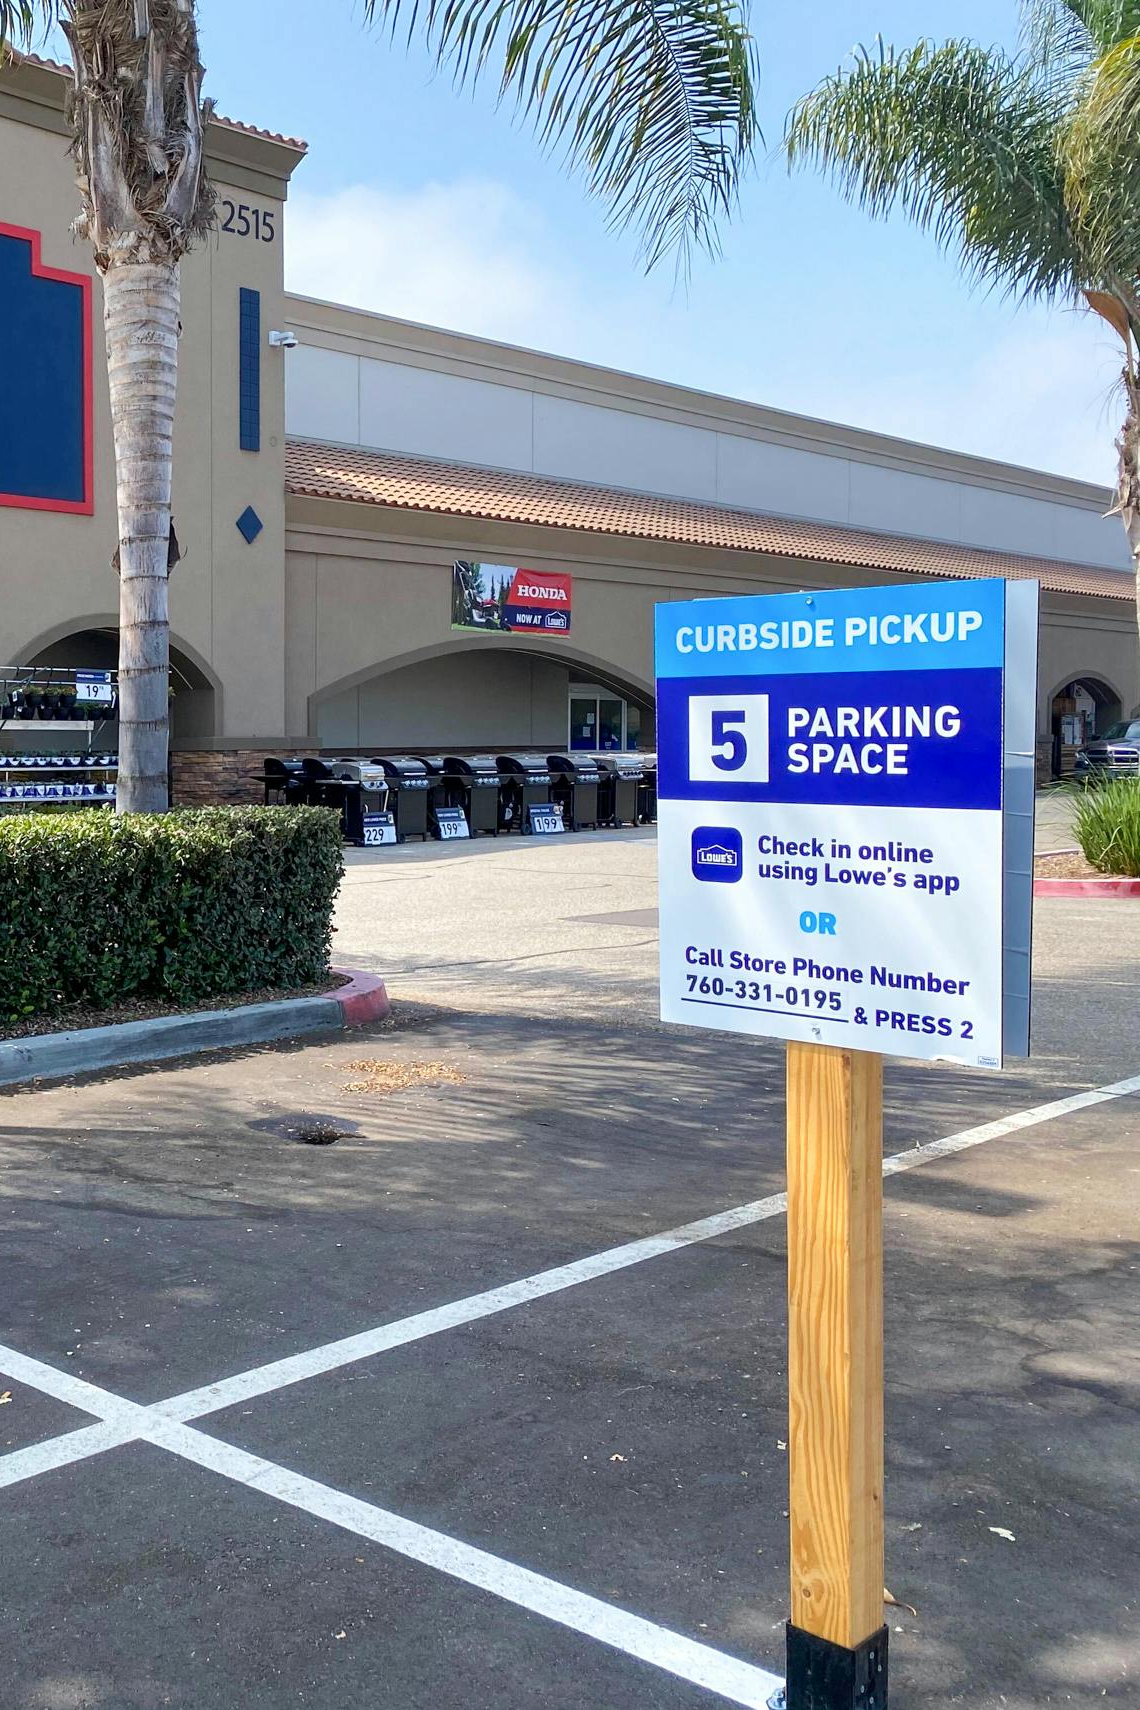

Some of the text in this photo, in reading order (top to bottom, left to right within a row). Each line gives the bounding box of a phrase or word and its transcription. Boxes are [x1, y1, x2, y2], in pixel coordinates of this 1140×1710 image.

[222, 201, 274, 242] 2515
[517, 585, 567, 600] HONDA
[516, 613, 542, 625] NOW AT
[675, 610, 983, 654] CURBSIDE PICKUP
[787, 705, 961, 738] PARKING
[711, 710, 748, 772] 5
[787, 743, 909, 775] SPACE
[701, 852, 733, 864] LOWE'S
[758, 835, 934, 864] Check in online
[758, 861, 960, 896] using Lowe's app
[799, 911, 837, 935] OR
[685, 946, 970, 996] Call Store Phone Number
[686, 974, 974, 1040] 760-331-0195 & PRESS 2
